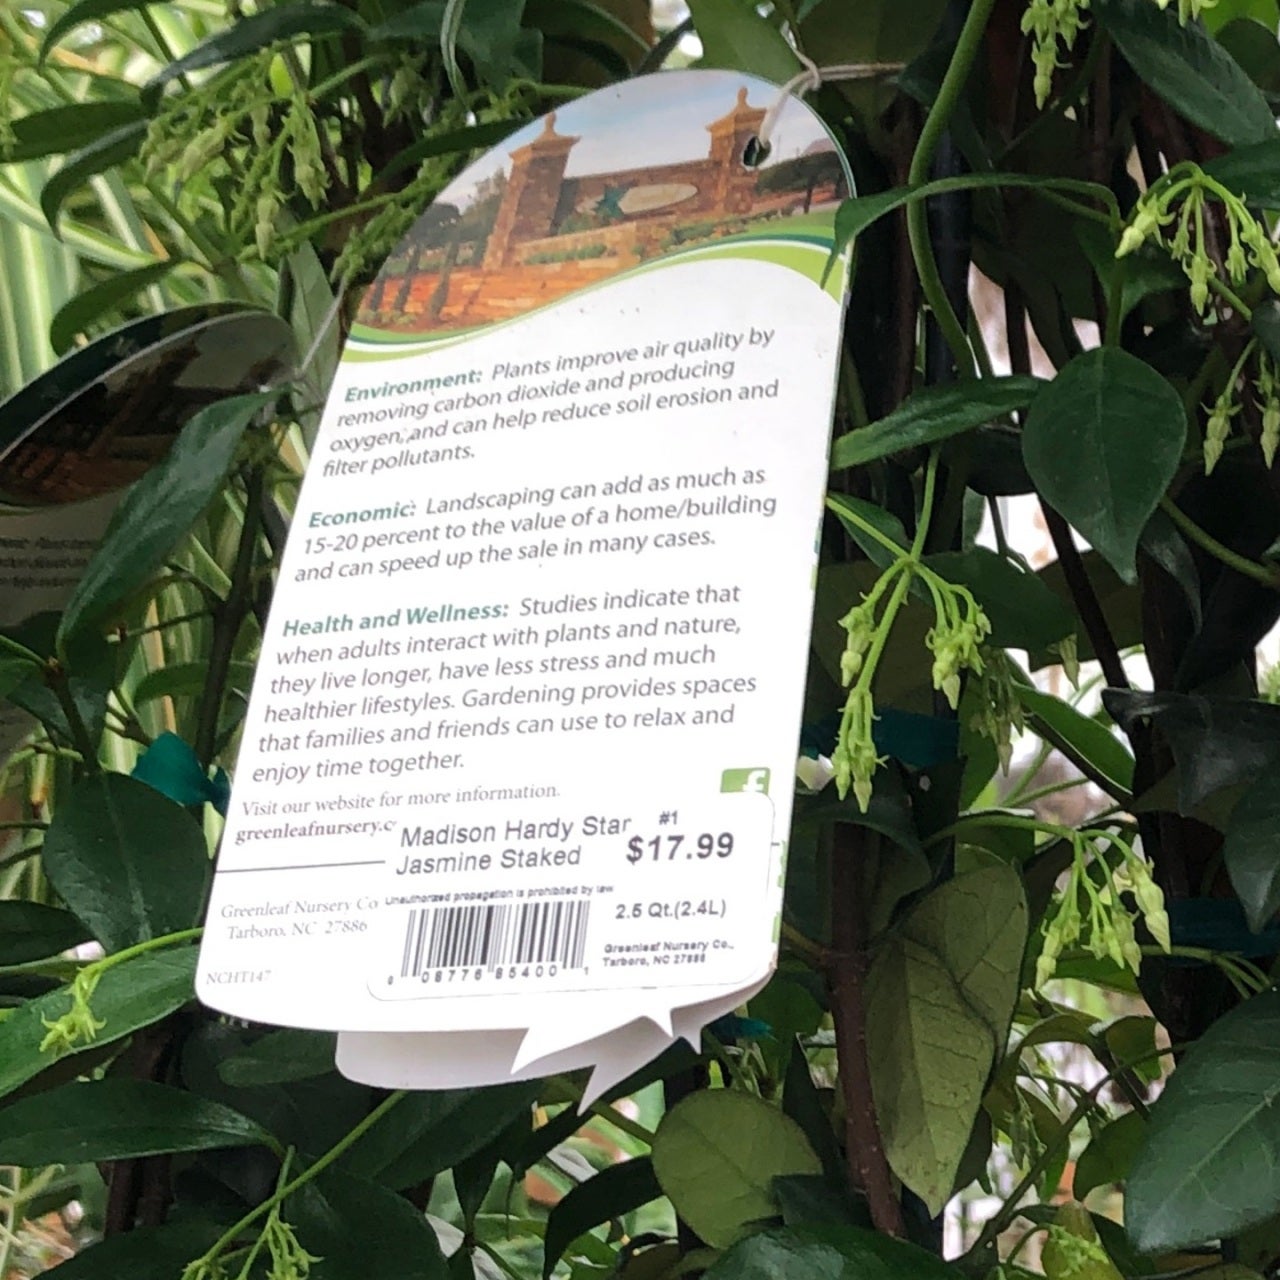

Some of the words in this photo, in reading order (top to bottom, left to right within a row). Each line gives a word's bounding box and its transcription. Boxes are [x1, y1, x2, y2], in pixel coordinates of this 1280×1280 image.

[345, 370, 482, 402] Environment:
[492, 361, 550, 380] Plants
[556, 348, 638, 372] improve
[643, 341, 669, 359] air
[673, 331, 744, 358] quality
[749, 327, 775, 348] by
[337, 402, 429, 427] removing
[434, 392, 501, 413] carbon
[507, 378, 580, 402] dioxide
[585, 371, 624, 392] and
[629, 360, 735, 391] producing
[411, 420, 447, 440] and
[452, 419, 487, 435] can
[493, 409, 537, 429] help
[542, 402, 611, 423] reduce
[616, 393, 651, 414] soil
[656, 387, 732, 409] erosion
[738, 379, 779, 400] and
[322, 458, 367, 477] filter
[370, 444, 476, 475] pollutants.
[309, 500, 416, 528] Economic:
[426, 488, 554, 514] Landscaping
[560, 484, 596, 500] can
[602, 474, 643, 496] add
[648, 477, 669, 492] as
[676, 466, 736, 489] much
[742, 470, 765, 484] as
[305, 533, 358, 554] 15-20
[362, 526, 440, 552] percent
[446, 524, 466, 539] to
[472, 518, 505, 536] the
[511, 512, 566, 532] value
[571, 507, 594, 526] of
[597, 511, 609, 524] a
[616, 494, 776, 522] home/building
[295, 561, 334, 582] and
[338, 562, 373, 577] can
[379, 550, 441, 576] speed
[446, 552, 473, 569] up
[479, 544, 512, 563] the
[518, 539, 558, 560] sale
[564, 538, 582, 555] in
[589, 536, 648, 554] many
[653, 531, 715, 548] cases.
[283, 614, 353, 637] Health
[359, 609, 401, 629] and
[407, 604, 509, 625] Wellness:
[520, 594, 597, 616] Studies
[603, 589, 690, 610] indicate
[696, 584, 741, 604] that
[277, 646, 332, 665] when
[338, 638, 400, 660] adults
[407, 633, 487, 653] interact
[493, 626, 538, 646] with
[545, 624, 610, 648] plants
[616, 617, 658, 638] and
[665, 618, 740, 635] nature,
[271, 676, 316, 696] they
[321, 672, 356, 690] live
[362, 668, 431, 688] longer,
[439, 662, 489, 680] have
[495, 657, 533, 675] less
[540, 656, 599, 673] stress
[605, 647, 647, 669] and
[653, 644, 715, 666] much
[264, 700, 357, 723] healthier
[361, 692, 455, 716] lifestyles.
[462, 684, 575, 707] Gardening
[581, 677, 676, 704] provides
[682, 677, 756, 699] spaces
[259, 734, 300, 752] that
[306, 727, 384, 748] families
[391, 721, 432, 742] and
[437, 717, 509, 738] friends
[516, 719, 553, 734] can
[561, 716, 598, 731] use
[605, 713, 627, 729] to
[634, 707, 686, 727] relax
[692, 704, 735, 725] and
[253, 763, 311, 785] enjoy
[317, 759, 363, 777] time
[369, 751, 464, 777] together.
[242, 801, 277, 816] Visit
[282, 802, 310, 814] our
[316, 795, 375, 812] website
[379, 791, 403, 807] for
[408, 792, 451, 805] more
[456, 784, 560, 802] information.
[235, 820, 397, 846] greenleafnursery.c
[400, 823, 496, 848] Madison
[504, 817, 574, 842] Hardy
[582, 815, 632, 836] Star
[659, 810, 678, 825] #1
[396, 852, 491, 875] Jasmine
[500, 845, 581, 869] Staked
[626, 832, 734, 865] $17.99
[581, 885, 593, 896] by
[221, 901, 290, 919] Greenleaf
[294, 899, 352, 915] Nursery
[615, 903, 642, 919] 2.5
[228, 924, 286, 940] Tarboro,
[292, 922, 317, 936] NC
[325, 920, 368, 934] 27886
[653, 955, 670, 965] NC
